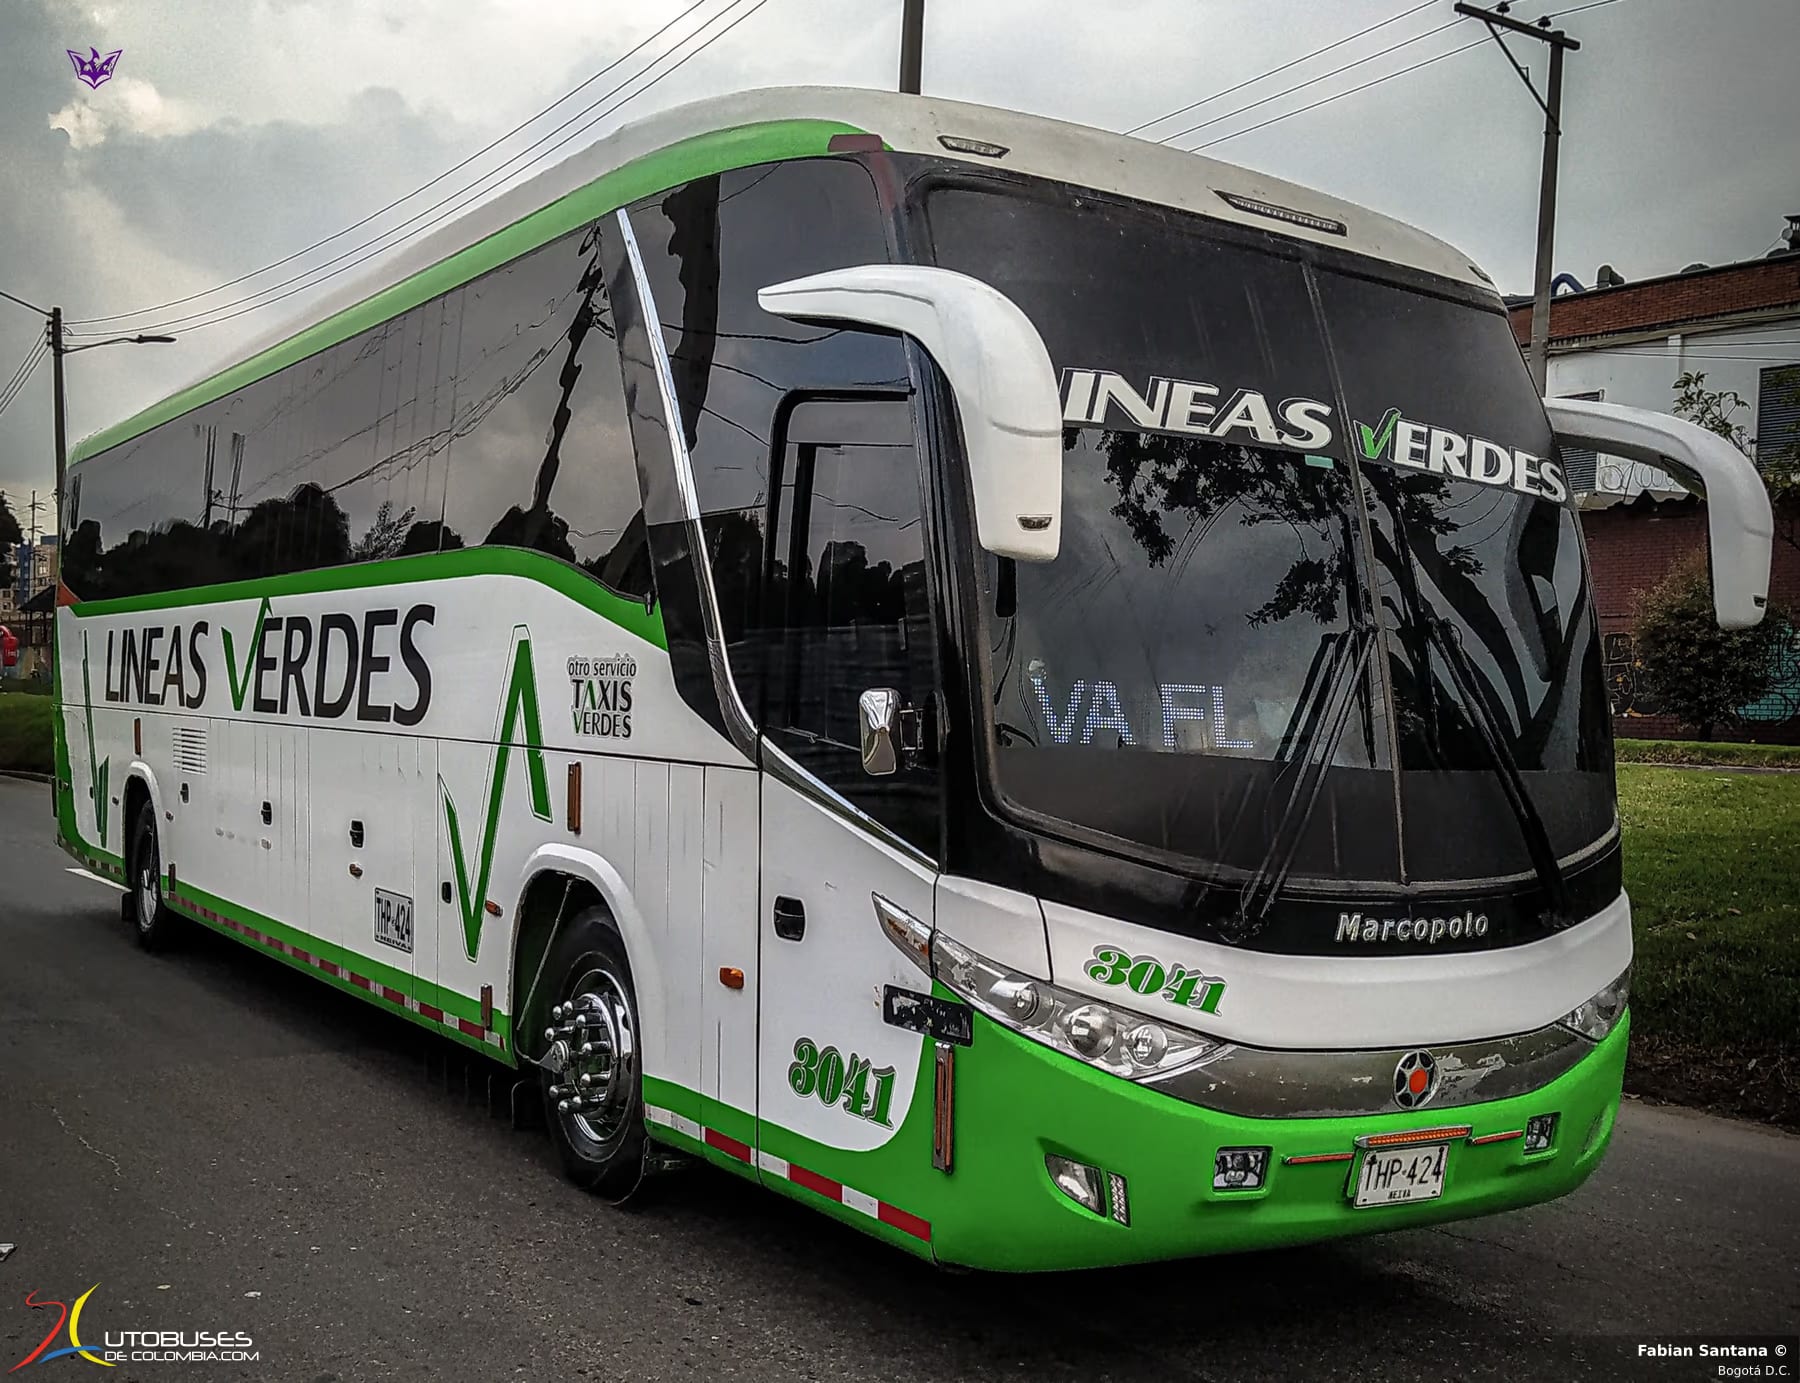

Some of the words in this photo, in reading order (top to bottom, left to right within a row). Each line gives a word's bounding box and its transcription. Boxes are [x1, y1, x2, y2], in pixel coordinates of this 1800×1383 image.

[1059, 368, 1332, 449] INEAS
[1353, 407, 1567, 503] VERDES
[105, 620, 209, 709] LINEAS
[220, 597, 436, 726] VERDES
[568, 660, 590, 676] otro
[593, 658, 637, 677] servicio
[572, 679, 632, 713] TAXIS
[573, 711, 632, 738] VERDES
[1031, 679, 1136, 744] VA
[1160, 683, 1254, 748] FL
[1336, 910, 1489, 944] Marcopolo
[1084, 944, 1229, 1017] 3041
[788, 1036, 896, 1130] 3041
